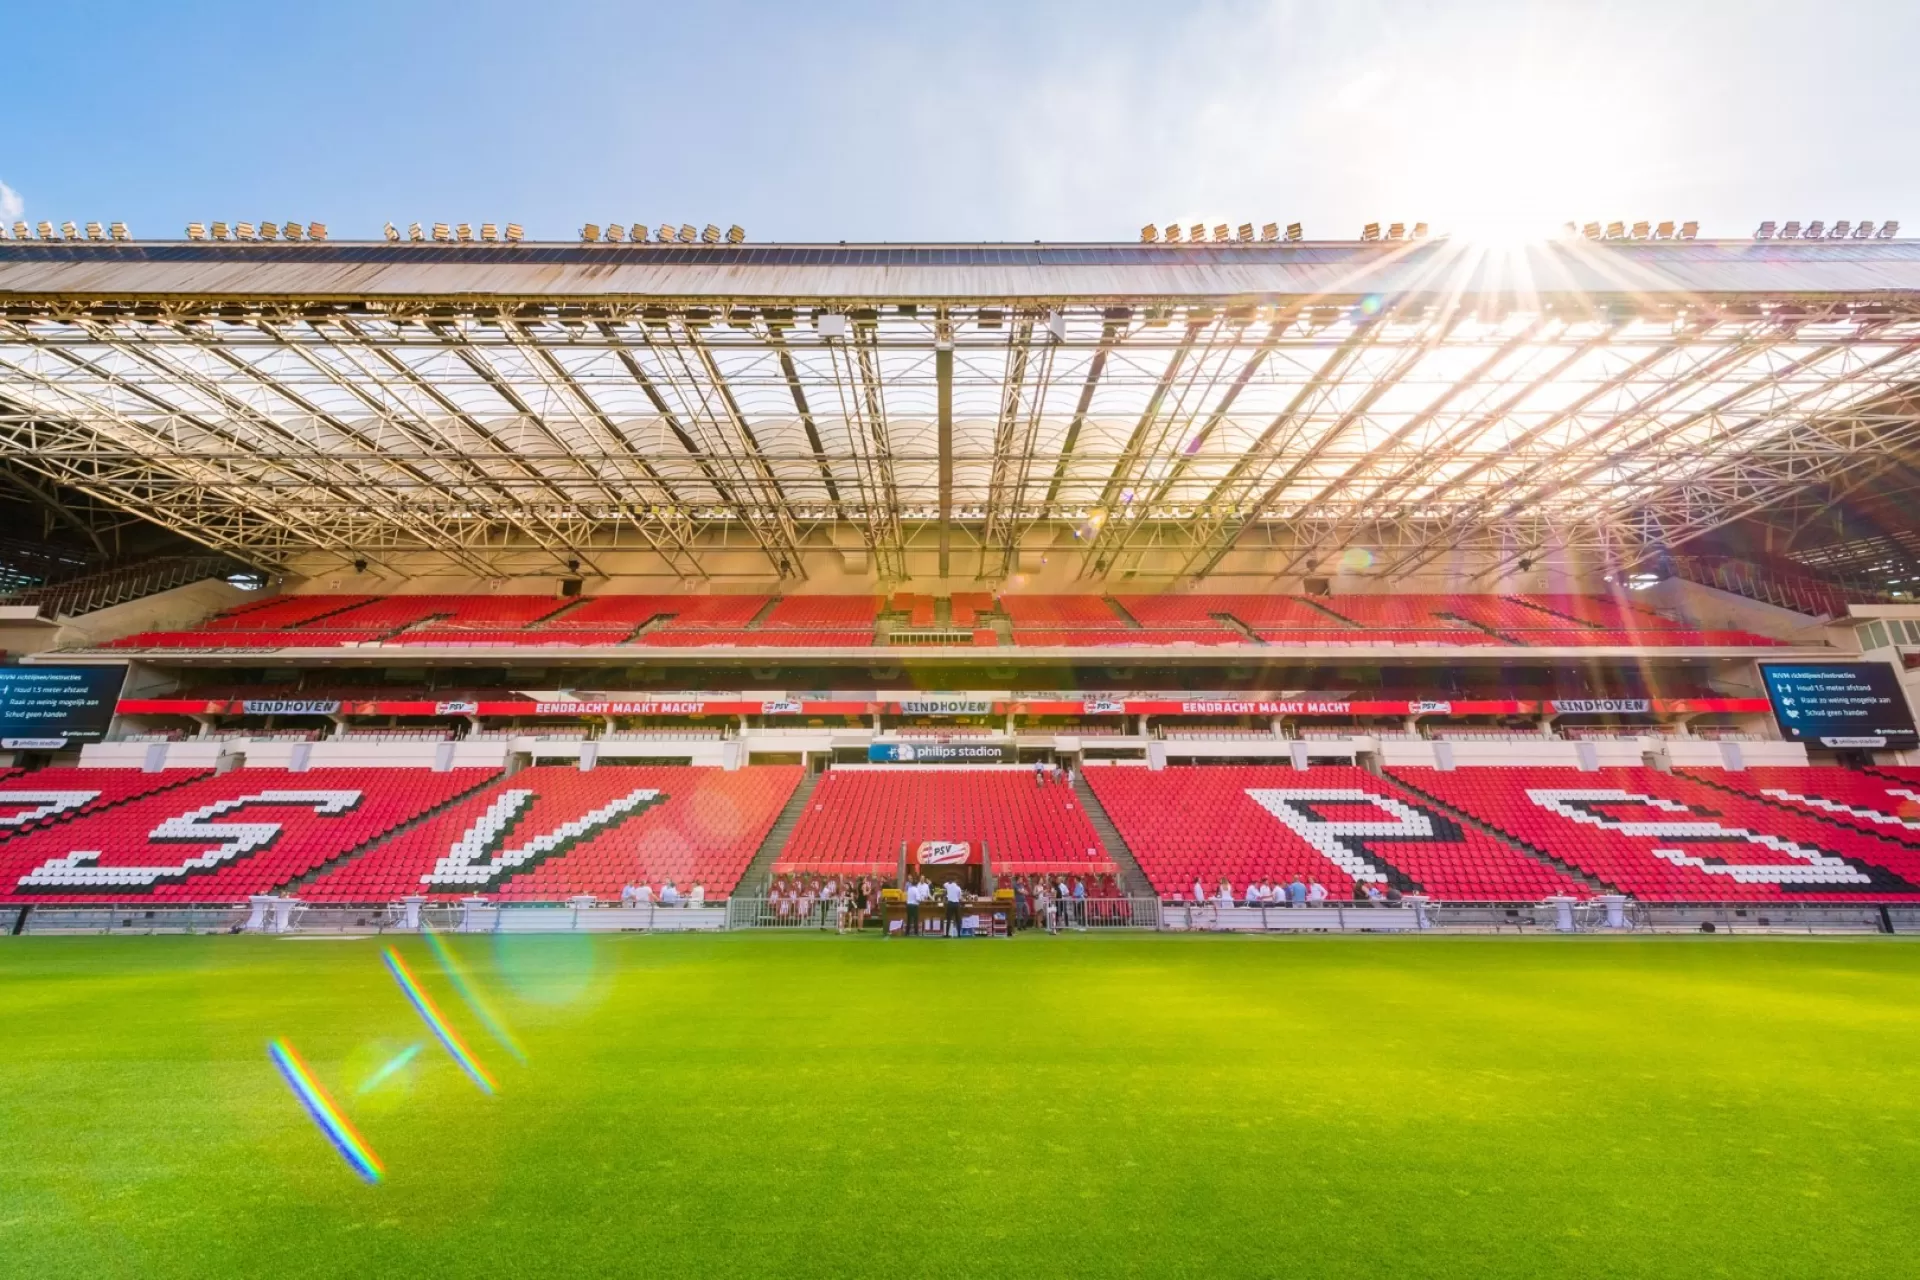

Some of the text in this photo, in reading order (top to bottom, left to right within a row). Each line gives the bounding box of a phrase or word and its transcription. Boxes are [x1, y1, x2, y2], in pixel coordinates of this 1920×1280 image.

[37, 698, 57, 707] weinig
[58, 698, 85, 707] mogelijk
[250, 700, 334, 712] EINDHOVEN
[774, 702, 789, 710] PSV
[907, 701, 986, 712] EINDHOVEN
[1096, 702, 1111, 710] PSV
[1560, 700, 1643, 712] EINDHOVEN
[1828, 697, 1850, 705] weinig
[1850, 697, 1877, 705] mogelijk
[536, 703, 704, 713] EENDRACHT MAAKT MACHT
[1182, 702, 1350, 713] EENDRACHT MAAKT MACHT
[917, 746, 1002, 758] philips stadion
[934, 844, 953, 856] PSV
